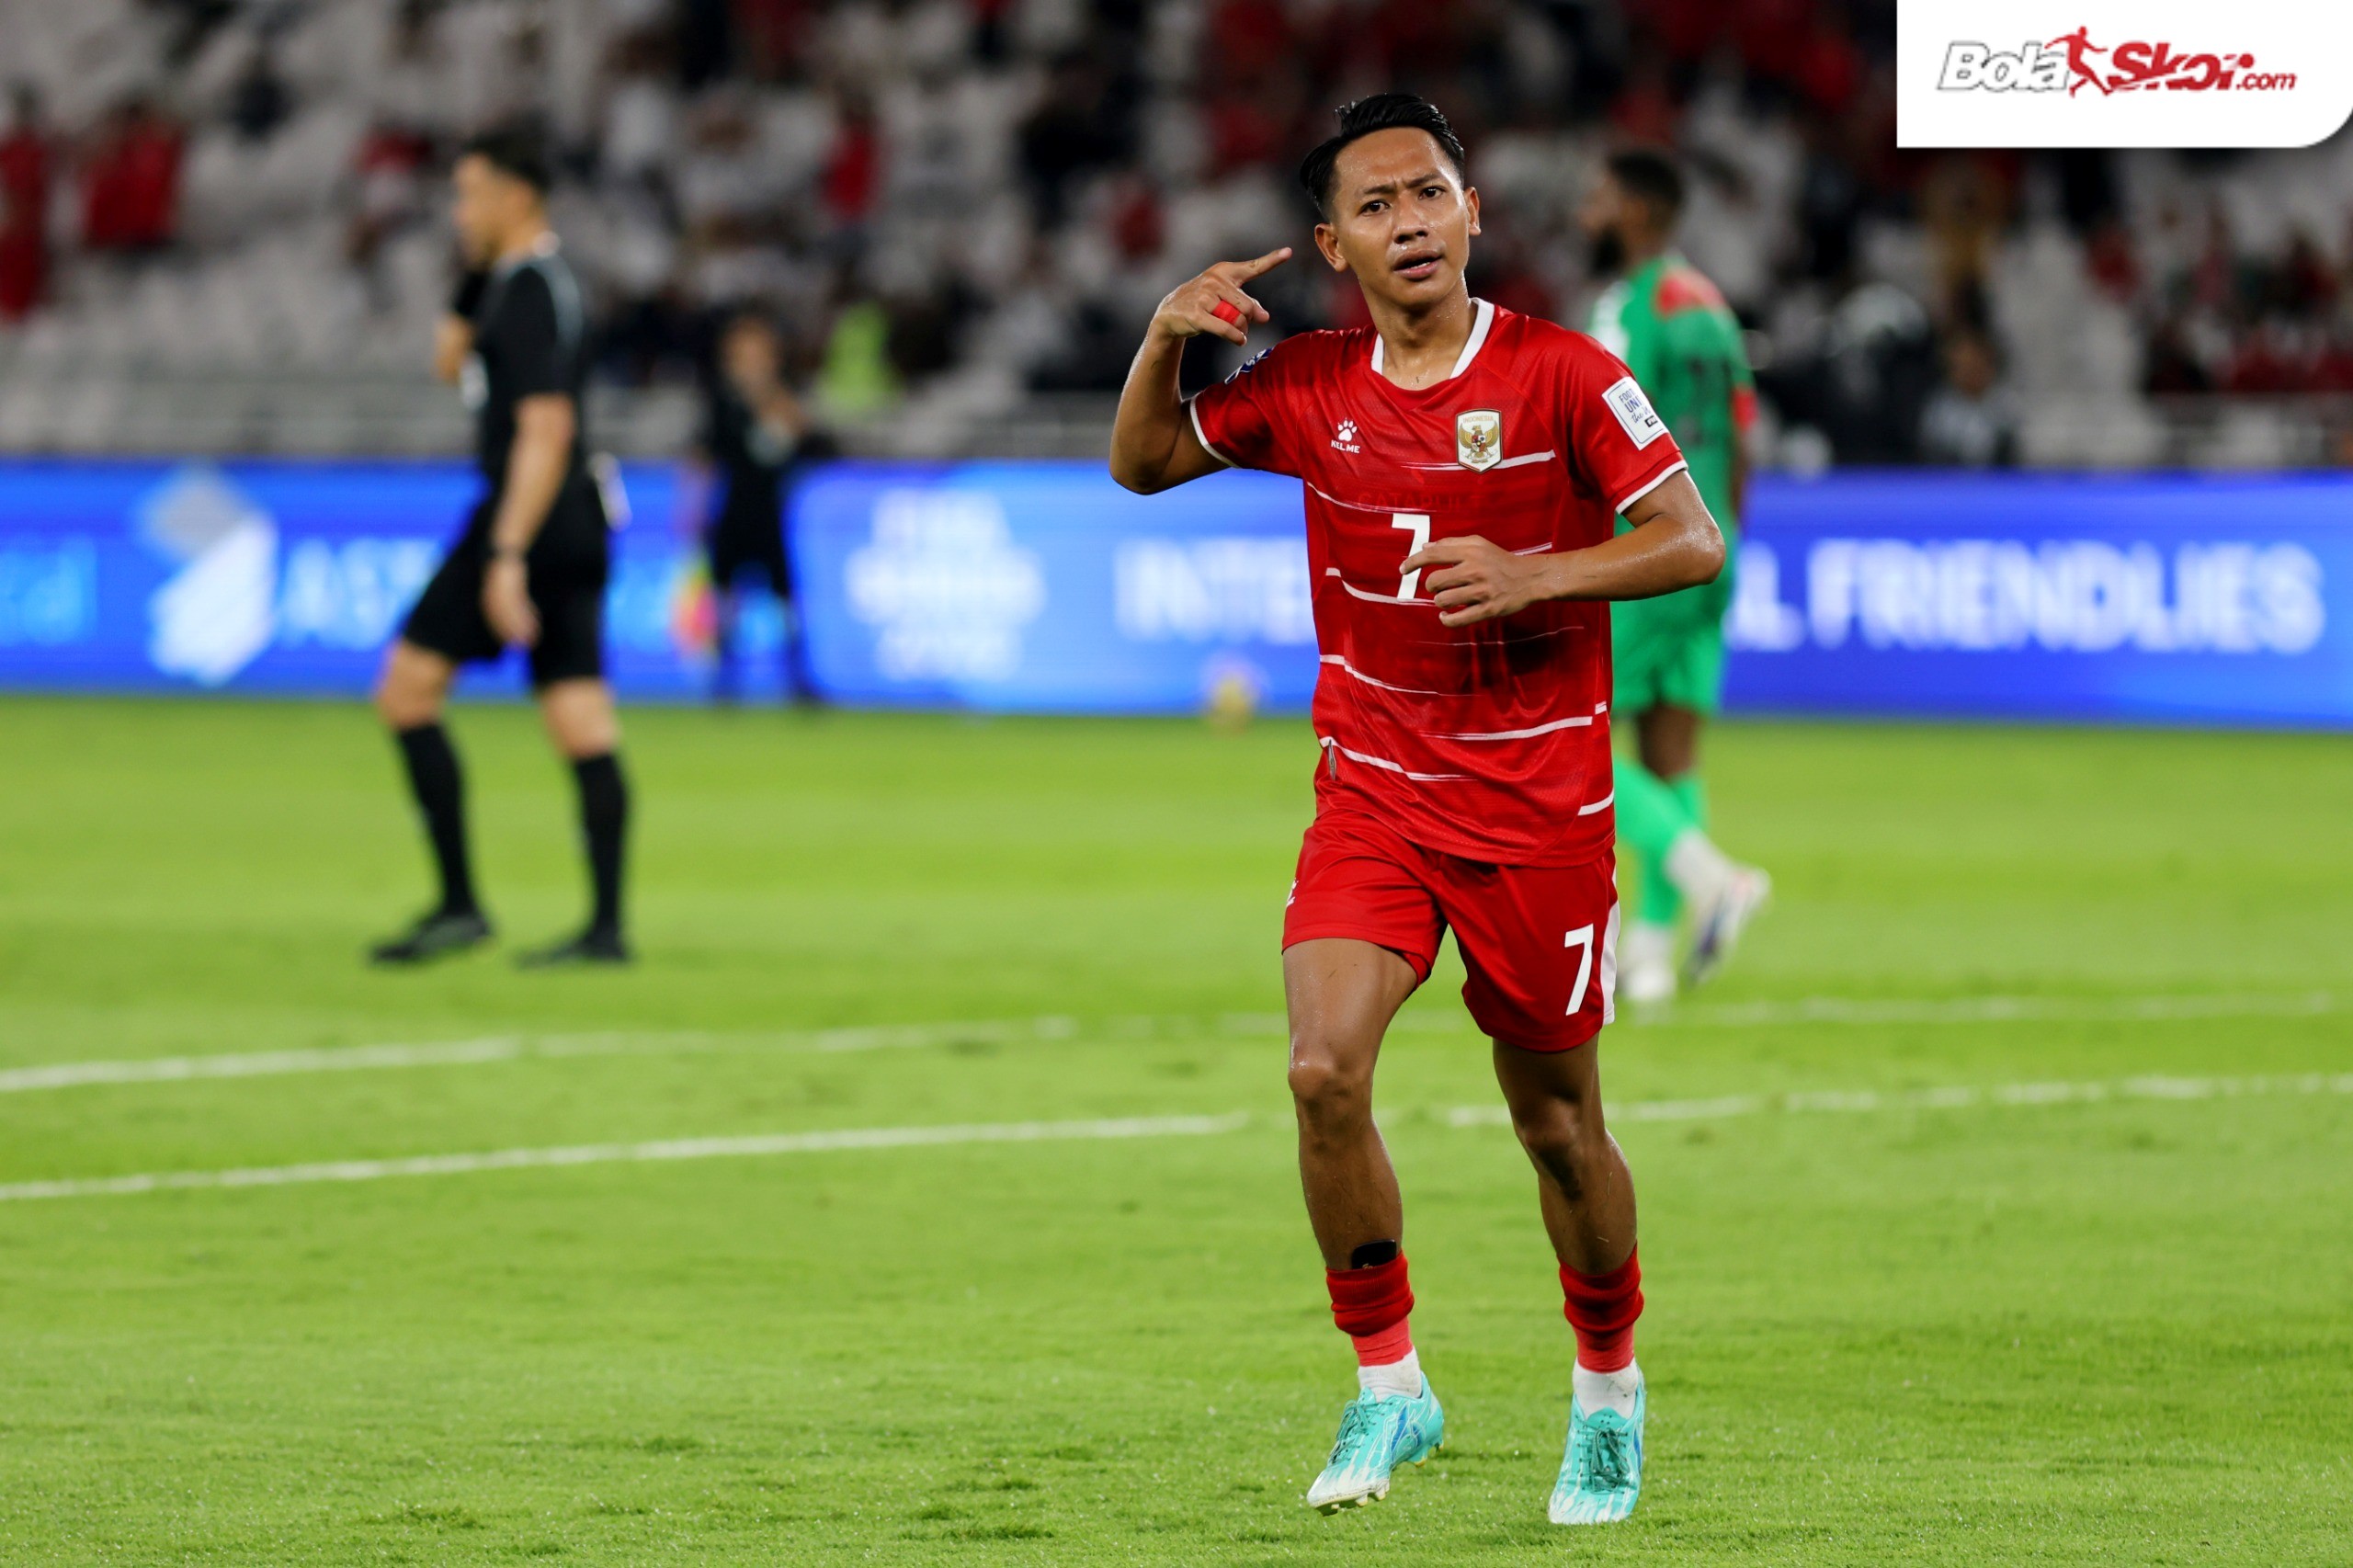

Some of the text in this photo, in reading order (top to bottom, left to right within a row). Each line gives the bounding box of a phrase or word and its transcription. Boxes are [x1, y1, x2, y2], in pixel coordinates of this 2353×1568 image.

[1331, 439, 1360, 454] KELME
[1392, 513, 1430, 601] 7
[1808, 539, 2325, 653] FRIENDLIES
[1564, 923, 1594, 1017] 7
